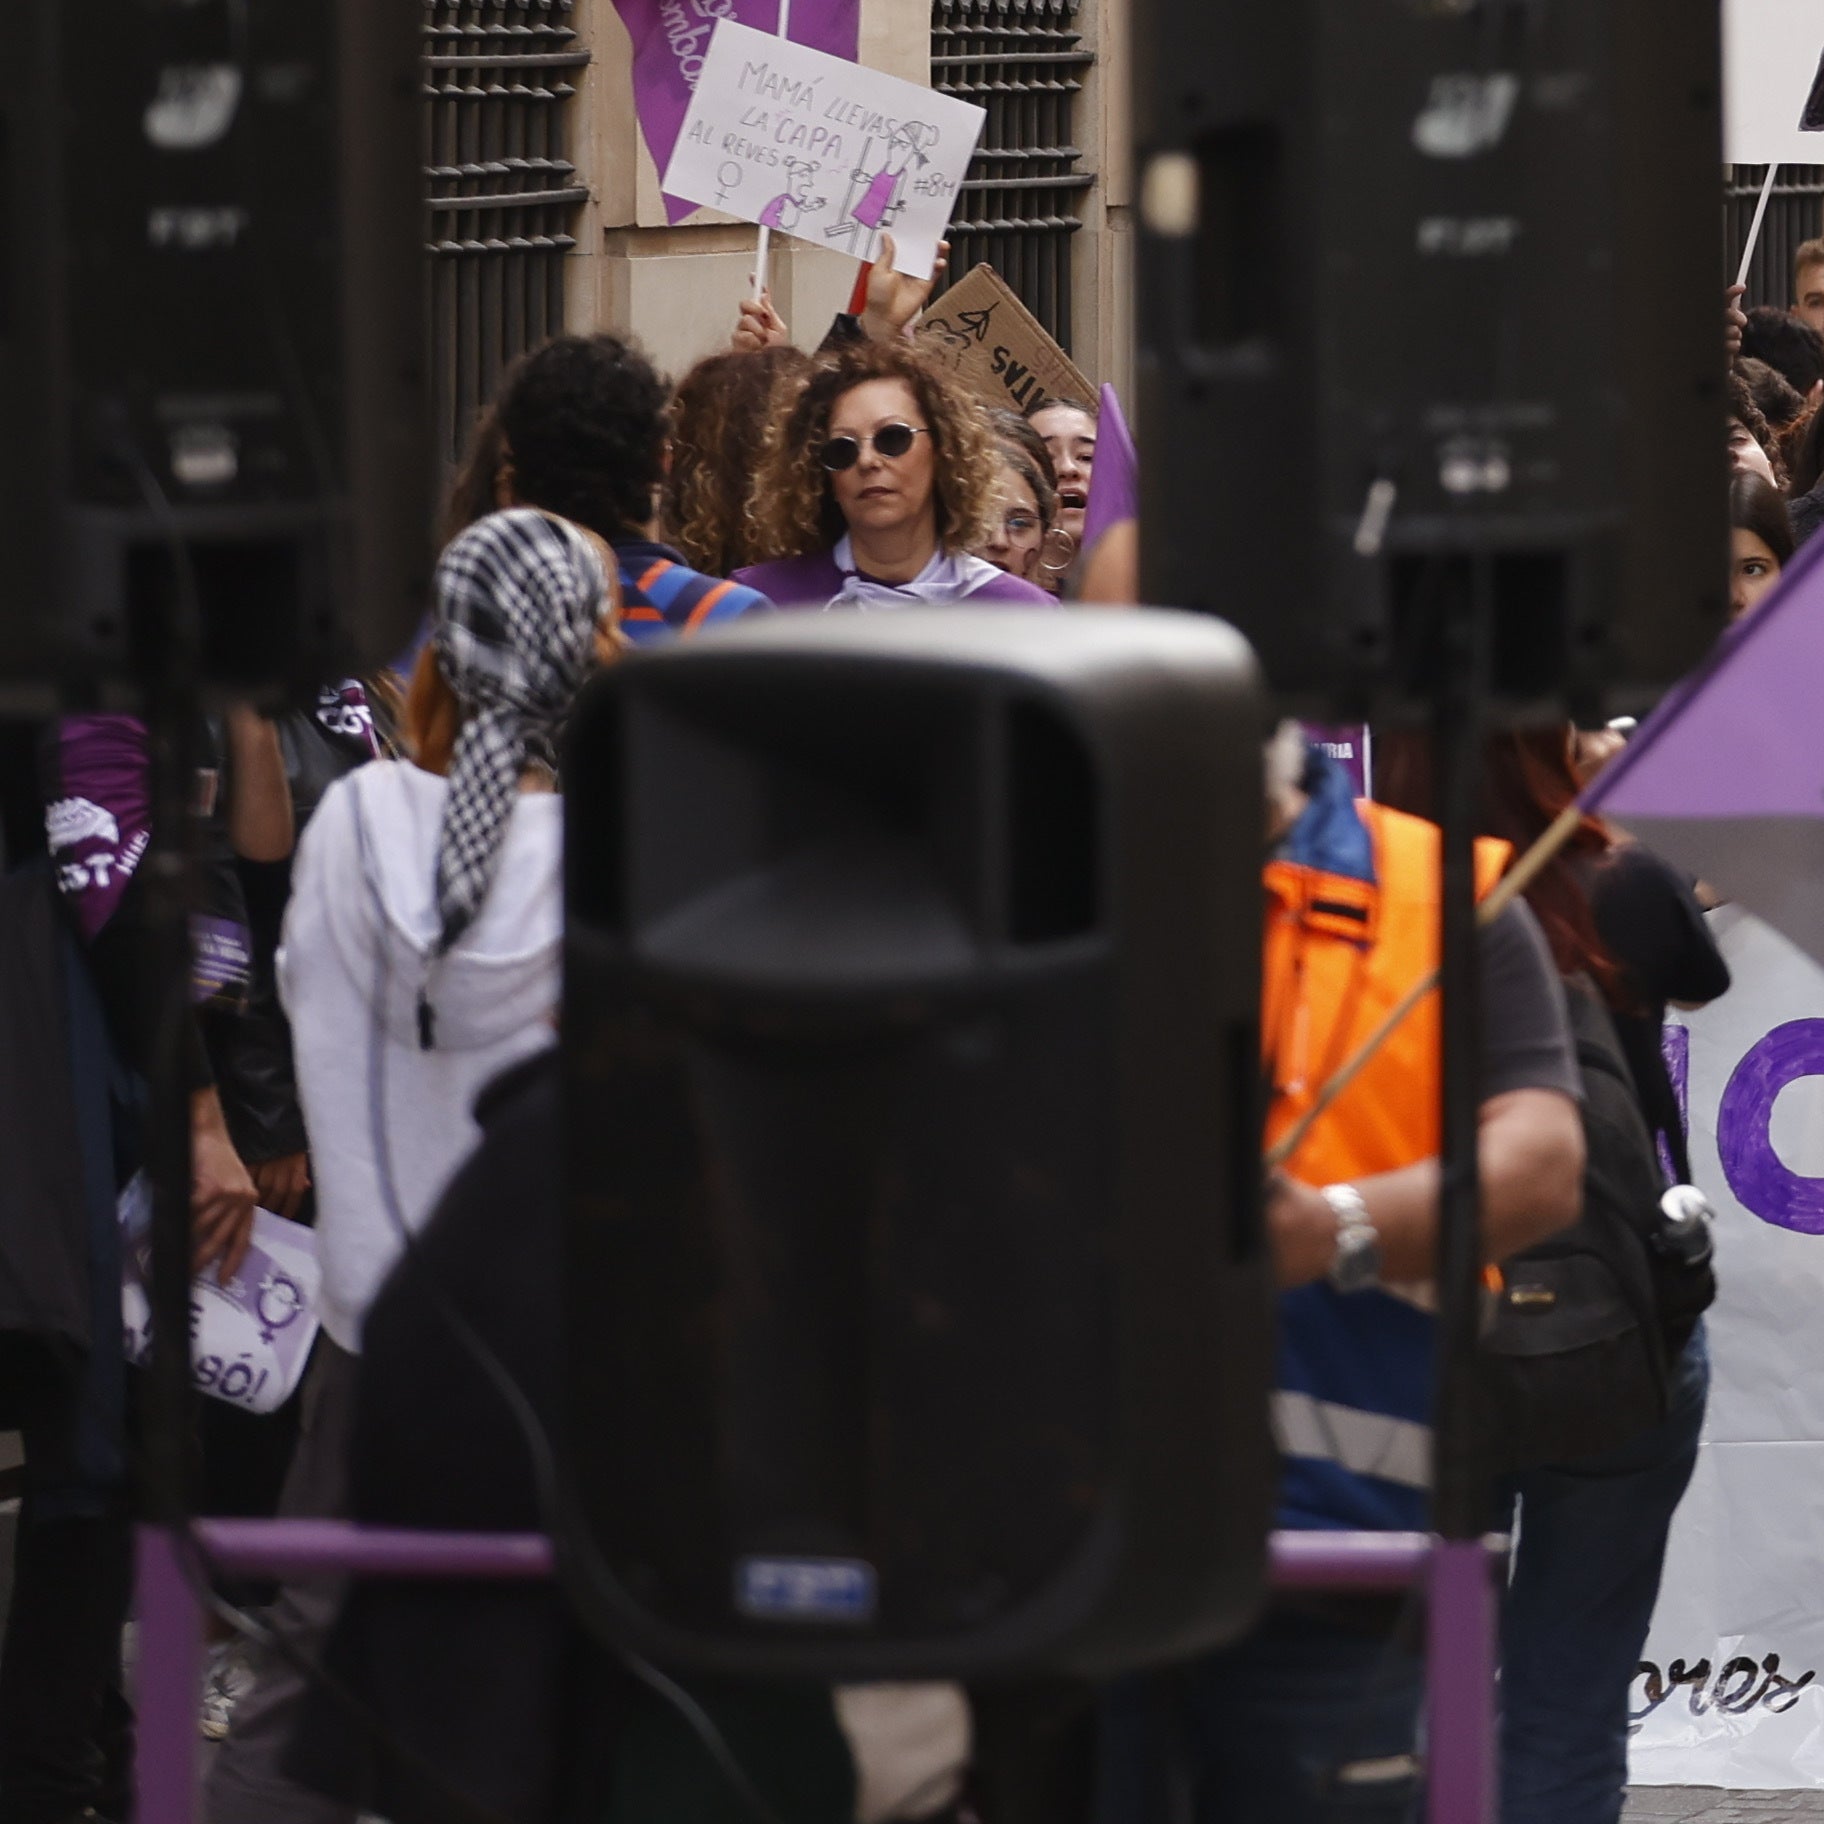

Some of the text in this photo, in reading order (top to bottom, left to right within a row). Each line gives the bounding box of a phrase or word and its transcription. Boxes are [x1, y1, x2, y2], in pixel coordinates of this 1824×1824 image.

[738, 60, 896, 139] MAMÁ LLEVAS
[687, 119, 712, 146] AL
[739, 105, 844, 160] LA CAPA
